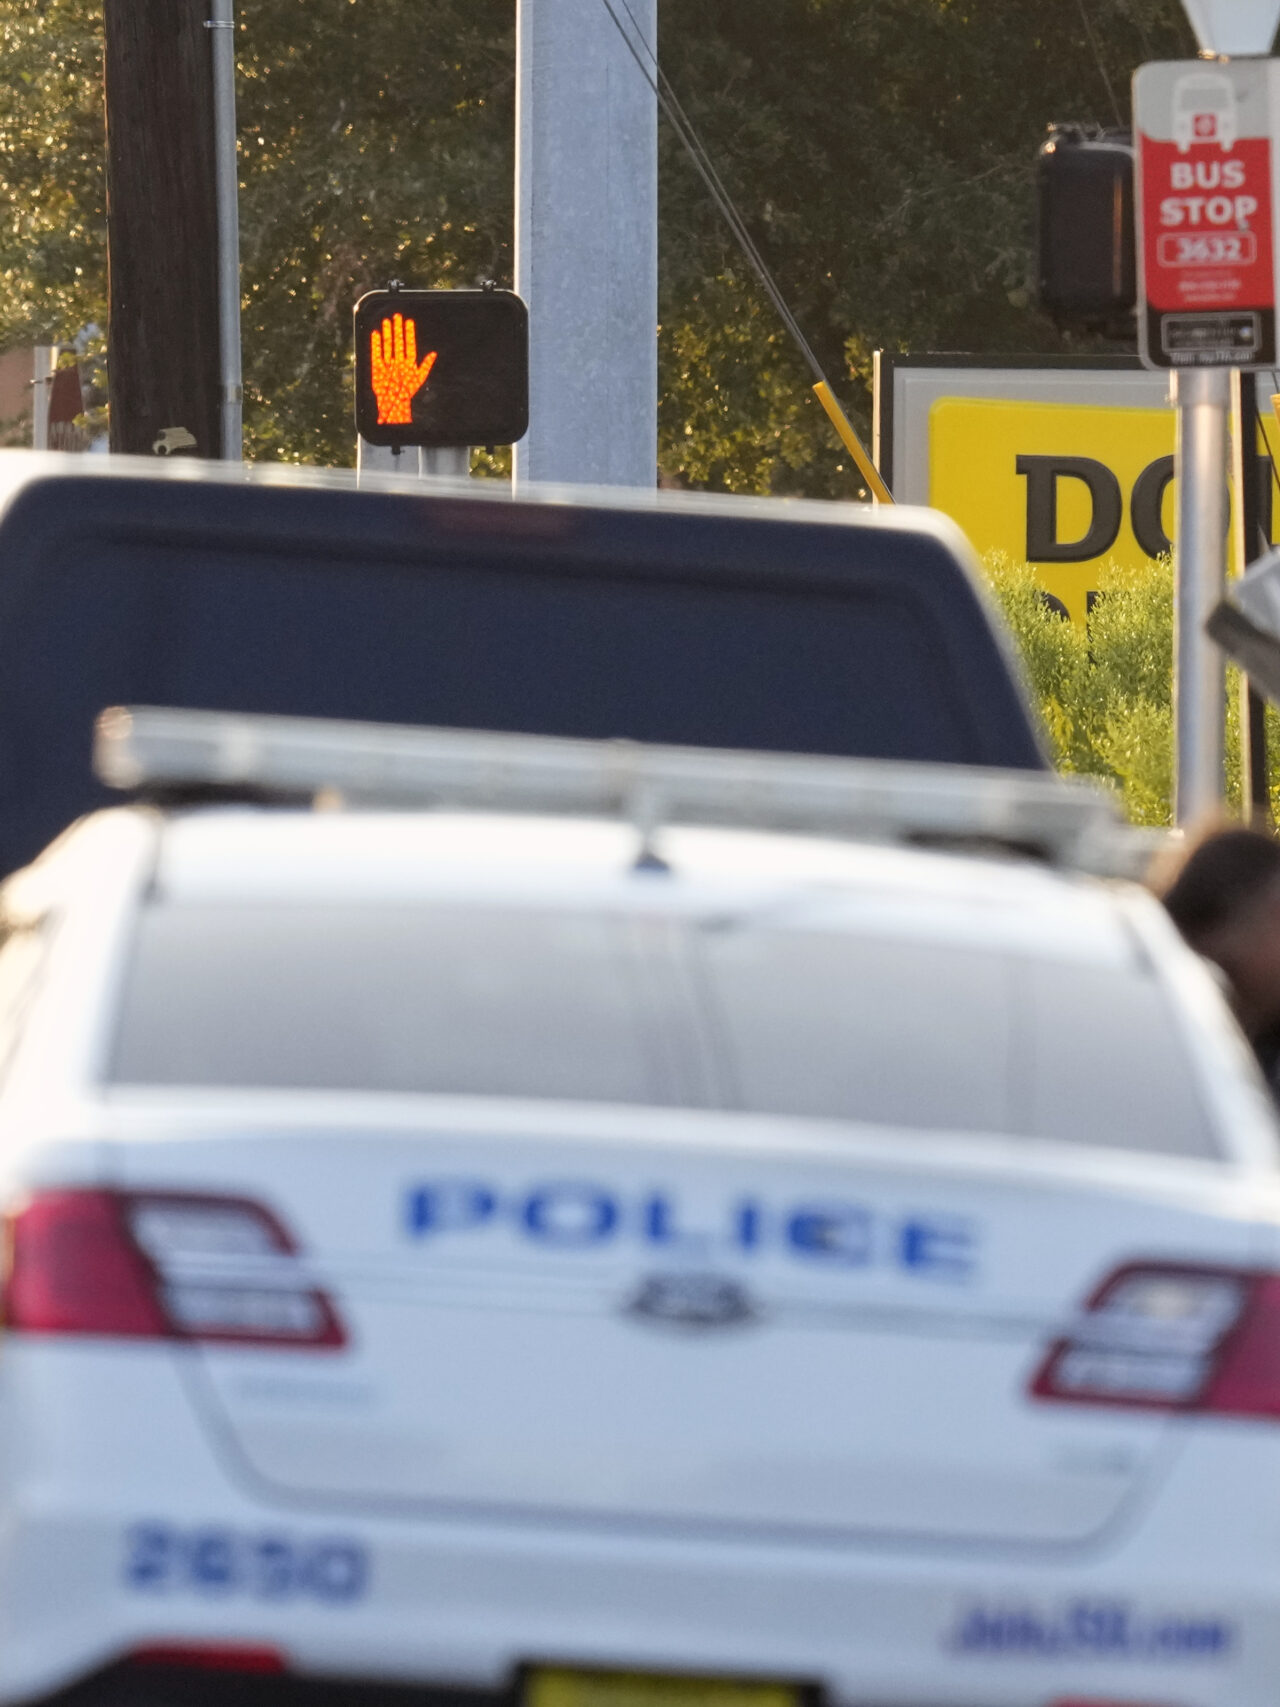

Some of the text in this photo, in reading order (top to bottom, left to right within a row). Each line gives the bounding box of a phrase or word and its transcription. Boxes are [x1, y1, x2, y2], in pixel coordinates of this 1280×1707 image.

[1170, 160, 1245, 190] BUS
[1160, 195, 1258, 226] STOP
[405, 1180, 980, 1277] POLICE
